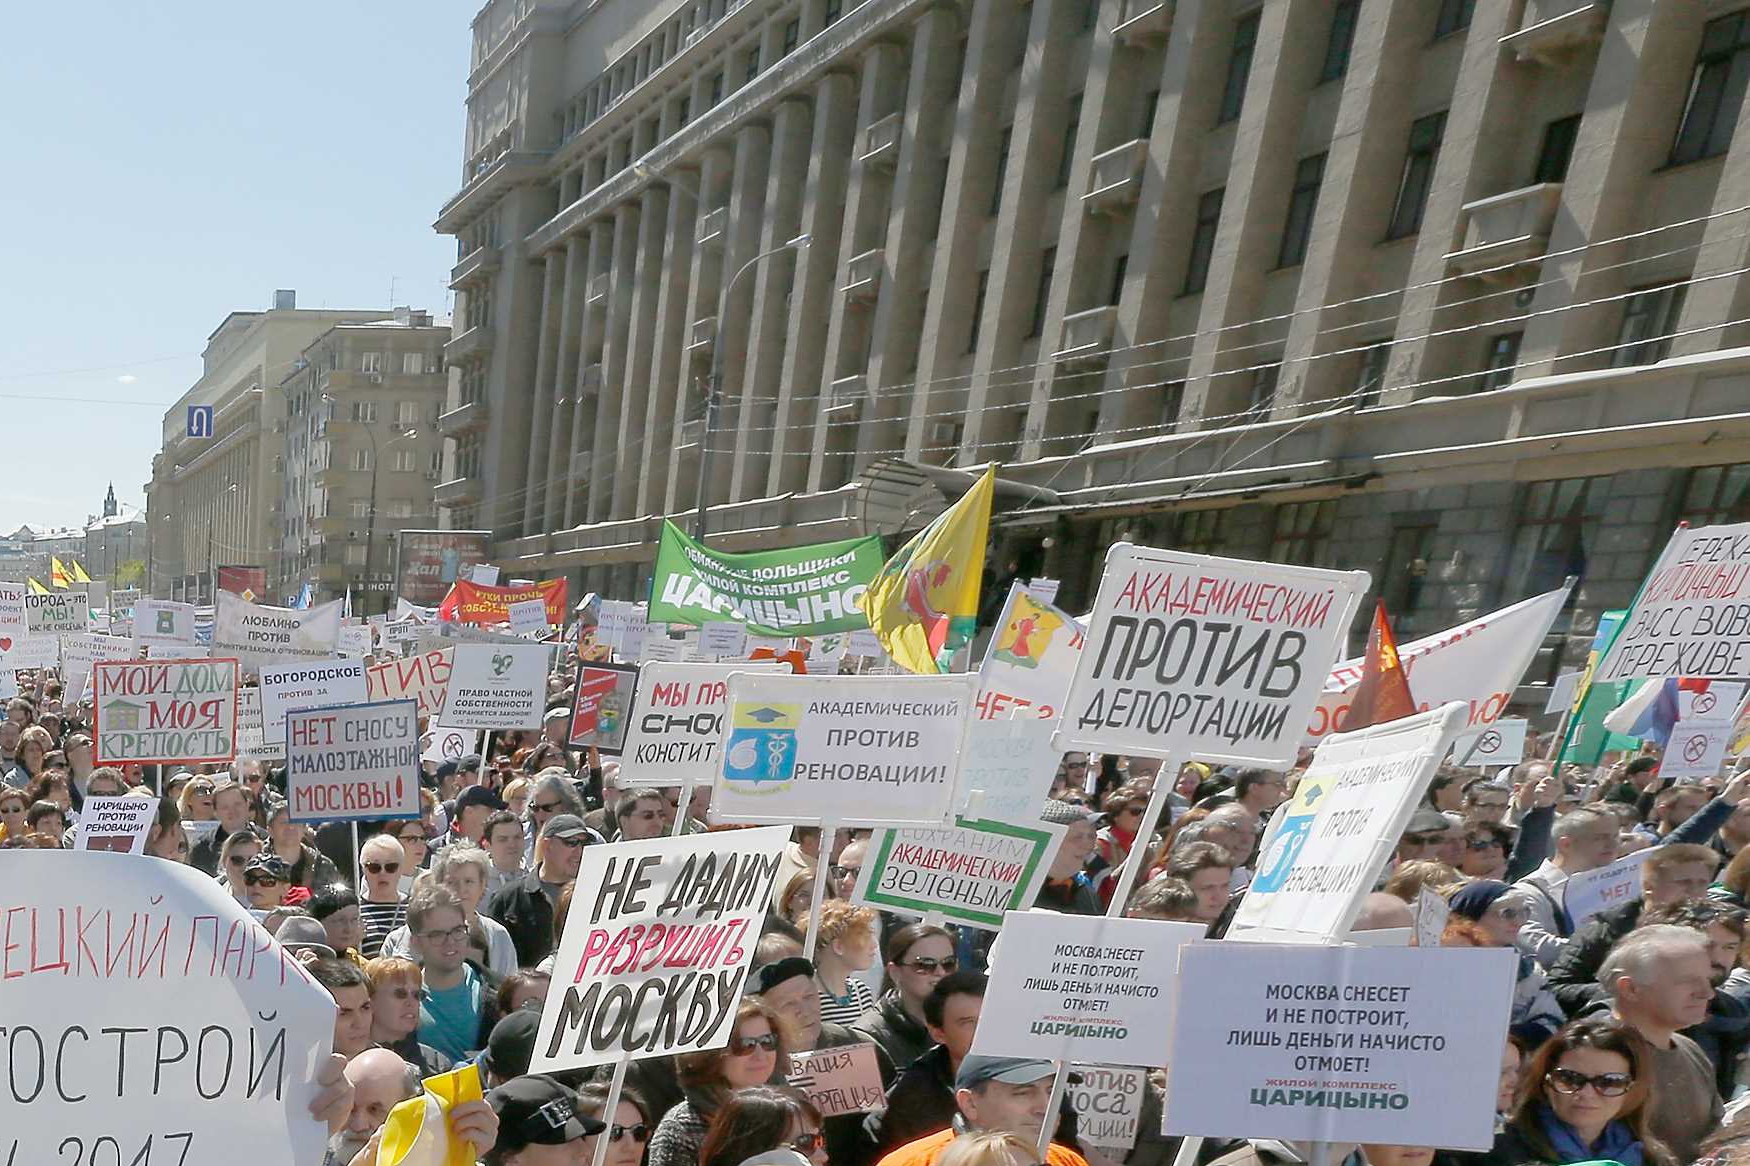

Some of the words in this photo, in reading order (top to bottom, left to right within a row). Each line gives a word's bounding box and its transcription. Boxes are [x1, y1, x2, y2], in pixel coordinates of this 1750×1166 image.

[752, 551, 856, 582] ДОЛЬЩИКИ
[742, 569, 851, 596] КОМПЛЕКС
[25, 595, 66, 609] ГОРОД
[1114, 571, 1335, 629] АКАДЕМИЧЕСКИЙ
[42, 607, 75, 622] МЫ!
[242, 615, 300, 629] ЛЮБЛИНО
[248, 632, 291, 643] ПРОТИВ
[1092, 615, 1307, 698] ПРОТИВ
[1606, 640, 1750, 680] ПЕРЕЖИВЕ
[100, 664, 174, 697] МОЙ
[173, 663, 234, 699] ДОМ
[264, 667, 362, 685] БОГОРОДСКОЕ
[278, 689, 313, 700] ПРОТИВ
[458, 689, 491, 698] ПРАВО
[492, 689, 533, 698] ЧАСТНОЙ
[650, 681, 690, 707] МЫ
[146, 699, 226, 730] МОЯ
[452, 709, 497, 717] ОХРАНЯЕТСЯ
[455, 700, 533, 709] СОБСТВЕННОСТИ
[808, 700, 958, 717] АКАДЕМИЧЕСКИЙ
[1078, 688, 1292, 746] ДЕПОРТАЦИИ
[293, 717, 338, 747] НЕТ
[345, 716, 409, 743] СНОСУ
[826, 729, 920, 748] ПРОТИВ
[100, 731, 230, 760] КРЕПОСТЬ
[292, 741, 418, 775] МАЛОЭТАЖНОЙ
[794, 763, 947, 786] РЕНОВАЦИИ!
[296, 774, 403, 813] МОСКВЫ!
[92, 801, 149, 811] ЦАРИЦЫНО
[85, 823, 145, 833] РЕНОВАЦИИ
[97, 813, 137, 822] ПРОТИВ
[1320, 807, 1376, 840] ПРОТИВ
[890, 843, 1023, 885] АКАДЕМИЧЕСКИЙ
[589, 854, 663, 925] НЕ
[656, 849, 784, 920] ДАДИМ
[183, 914, 314, 987] ПАРК
[573, 918, 751, 984] РАЗРУШИТЬ
[1054, 944, 1103, 960] МОСКВА
[1051, 962, 1061, 973] И
[1062, 963, 1079, 975] НЕ
[1080, 964, 1140, 981] ПОТРОИТ,
[1023, 978, 1059, 991] ЛИШЬ
[1060, 980, 1103, 994] ДЕНЬИ
[1104, 983, 1160, 998] НАЧИСТО
[1265, 984, 1340, 1001] МОСКВА
[1343, 986, 1411, 1002] СНЕСЕТ
[545, 966, 745, 1059] МОСКВУ
[1063, 998, 1110, 1011] ОТМЕТ!
[1265, 1007, 1278, 1024] И
[1283, 1008, 1306, 1025] НЕ
[1311, 1009, 1410, 1030] ПОСТРОИТ,
[1030, 1021, 1129, 1040] ЦАРИЦЫНО
[1226, 1030, 1282, 1047] ЛИШЬ
[1285, 1032, 1354, 1050] ДЕНЬГИ
[1360, 1034, 1446, 1051] НАЧИСТО
[1294, 1055, 1370, 1073] ОТМОЕТ!
[1265, 1077, 1318, 1089] ЖИЛОЙ
[1322, 1080, 1398, 1091] КОМПЛЕКС
[1249, 1088, 1410, 1111] ЦАРИЦЫНО
